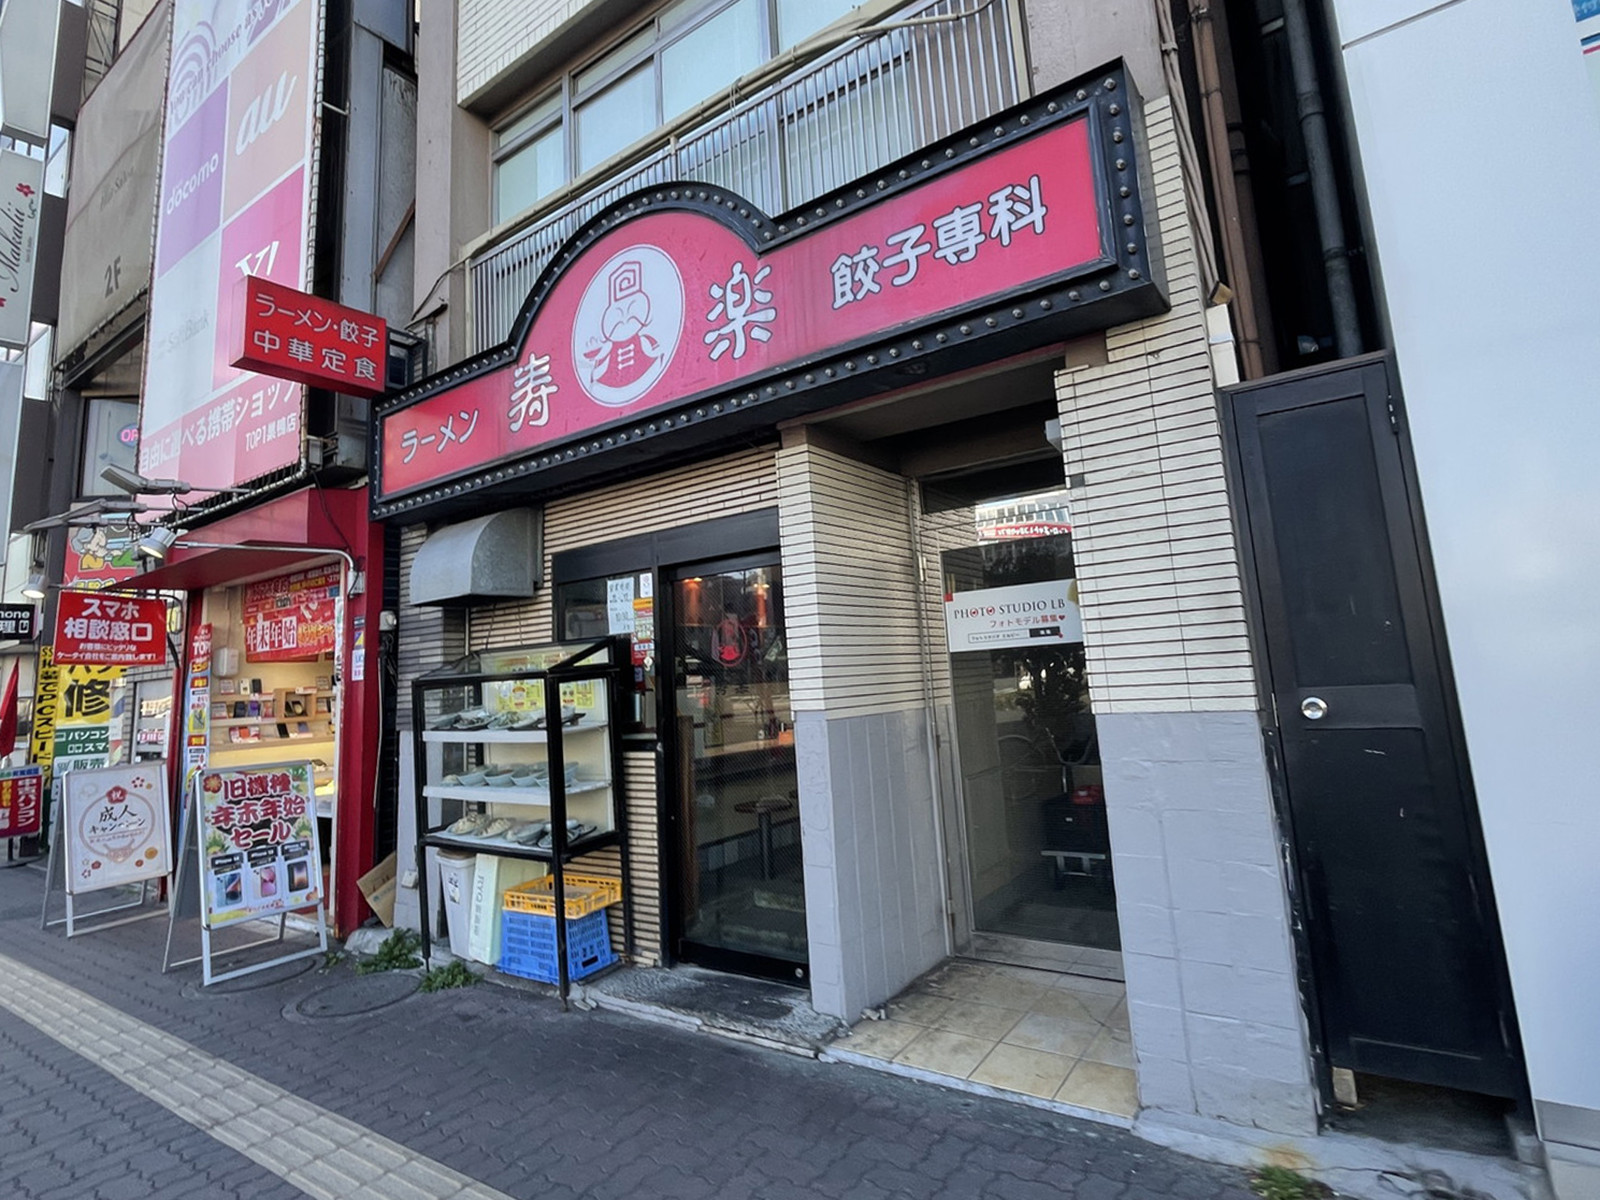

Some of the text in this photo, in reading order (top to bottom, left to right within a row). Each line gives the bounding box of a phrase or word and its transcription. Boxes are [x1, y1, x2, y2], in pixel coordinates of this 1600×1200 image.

[236, 70, 296, 155] au
[166, 152, 219, 215] docomo
[104, 255, 121, 298] 2F
[401, 174, 1047, 464] ラーメン 寿 楽 餃子専科
[253, 330, 377, 381] 中華定食
[81, 598, 140, 619] スマホ
[954, 598, 1066, 619] PHOTO STUDIO LB
[63, 617, 153, 641] 相談窓口
[63, 678, 110, 718] 修
[84, 742, 110, 753] スマ
[223, 773, 291, 800] 旧機種
[99, 804, 138, 823] 成人
[211, 796, 307, 827] 年末年始
[230, 821, 292, 848] セール
